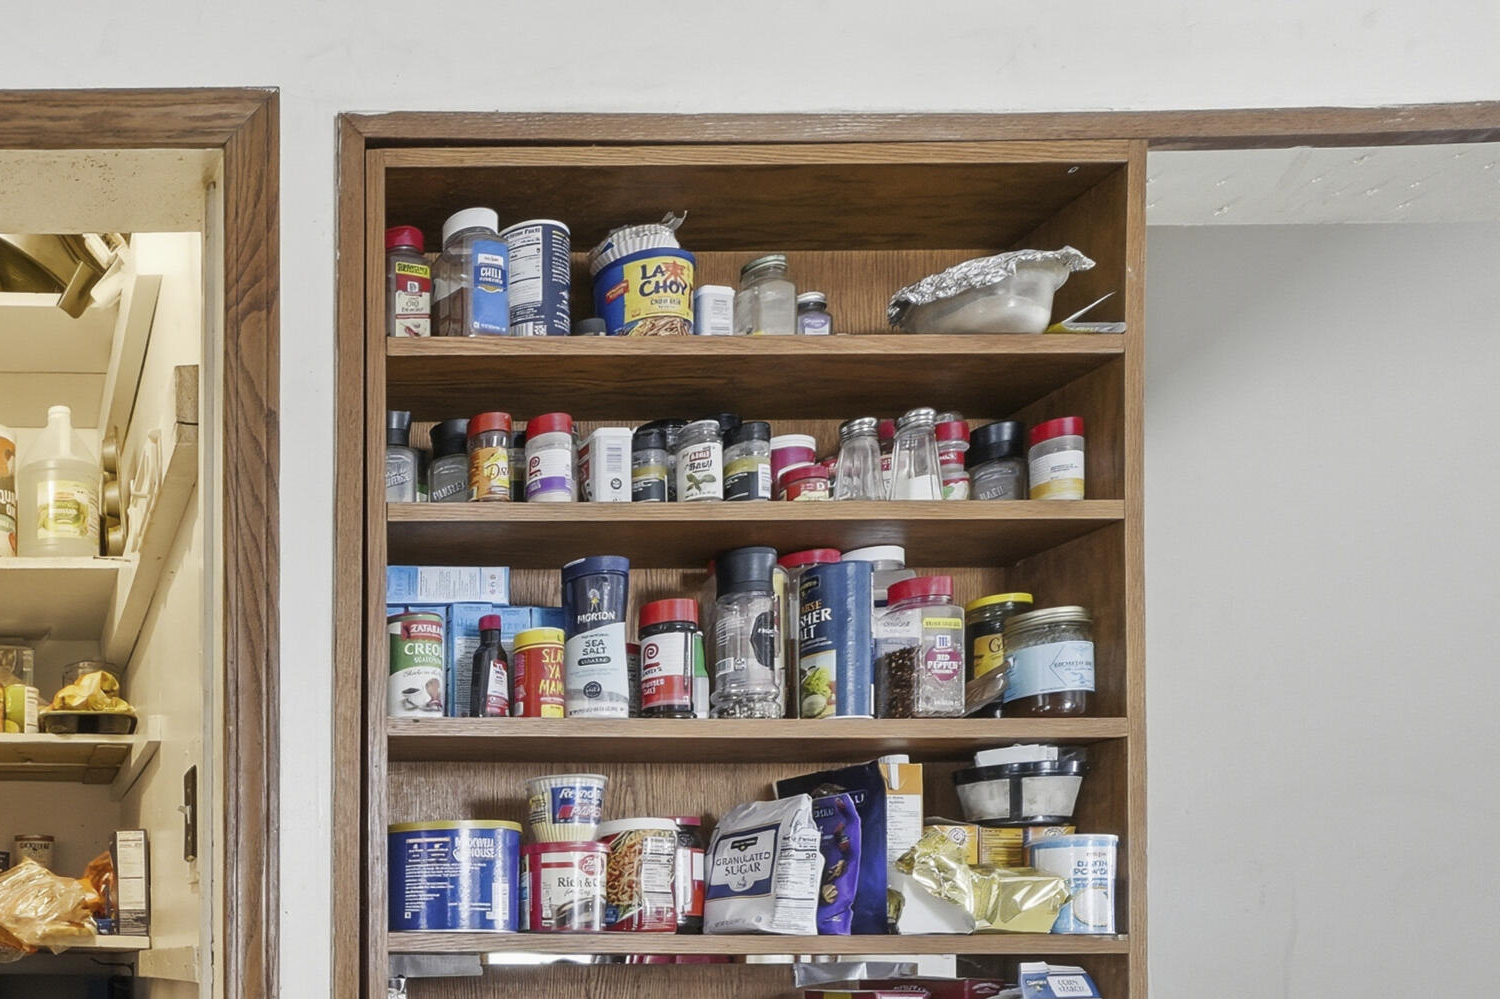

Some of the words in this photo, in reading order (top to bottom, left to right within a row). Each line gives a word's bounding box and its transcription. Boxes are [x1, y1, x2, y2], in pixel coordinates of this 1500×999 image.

[640, 263, 665, 280] LA
[639, 279, 687, 298] CHOY
[801, 599, 823, 611] ARSE
[577, 611, 616, 624] MORTON
[800, 607, 833, 627] SHER
[410, 623, 443, 635] ZATARA
[800, 625, 817, 640] LT
[585, 639, 605, 648] SEA
[582, 646, 607, 657] SALT
[549, 665, 561, 679] YA
[454, 836, 494, 848] MXWELL
[715, 851, 771, 867] GRANULATED
[724, 862, 761, 877] SUGAR
